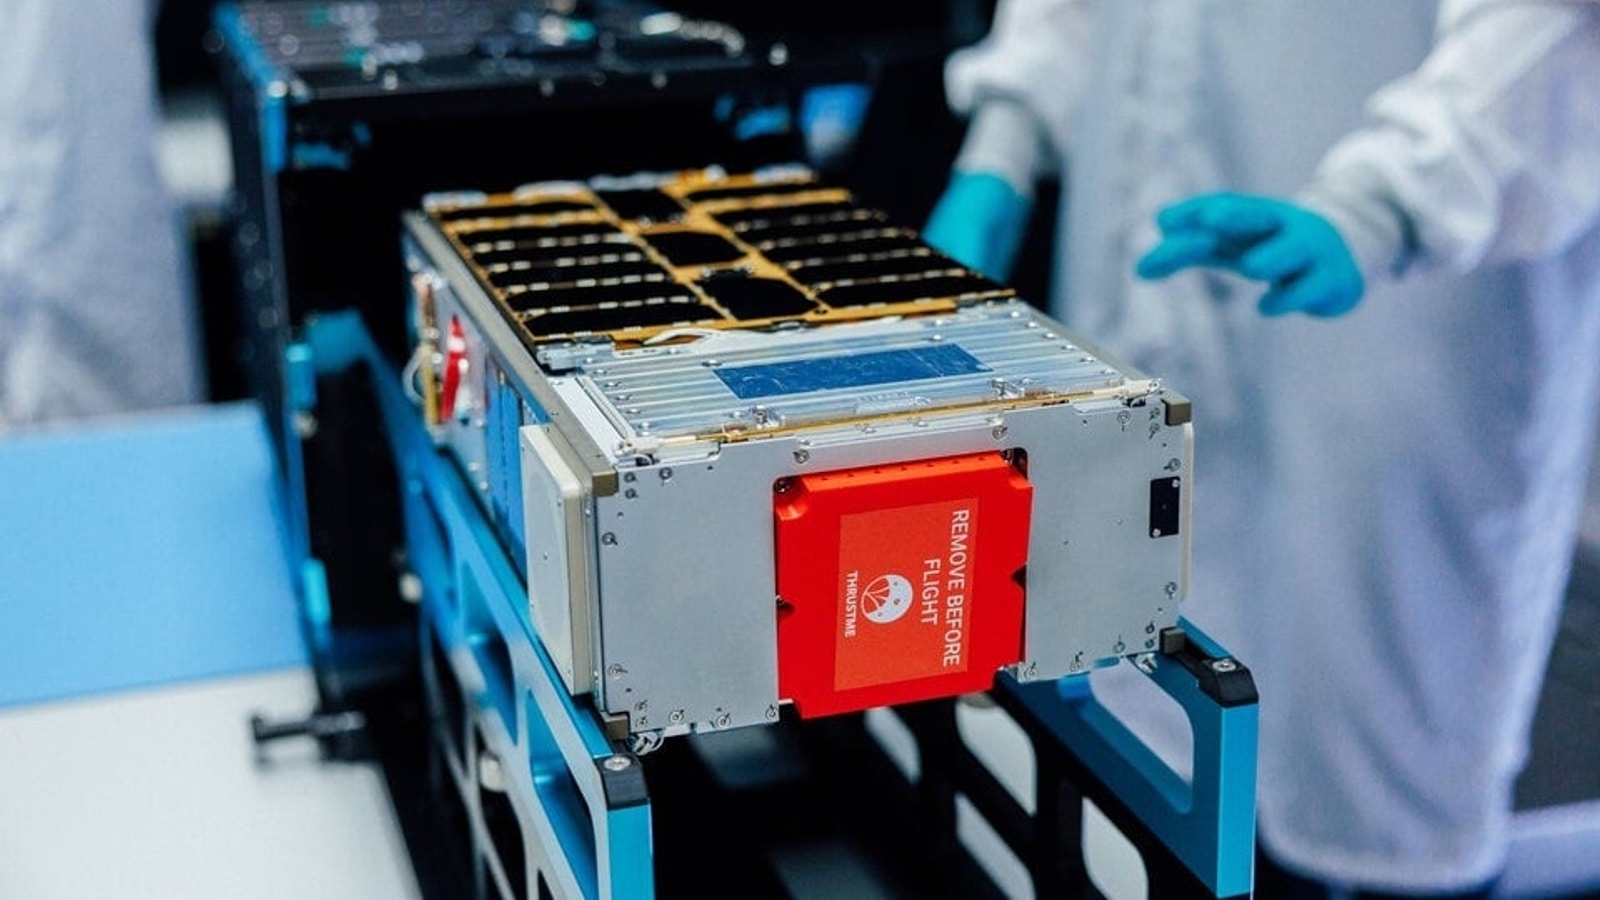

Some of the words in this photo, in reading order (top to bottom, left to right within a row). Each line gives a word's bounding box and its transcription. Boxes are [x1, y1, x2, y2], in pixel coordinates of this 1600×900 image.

[947, 509, 969, 591] REMOVE
[844, 570, 858, 638] THRUSTME
[920, 559, 941, 625] FLIGHT
[943, 595, 964, 667] BEFORE
